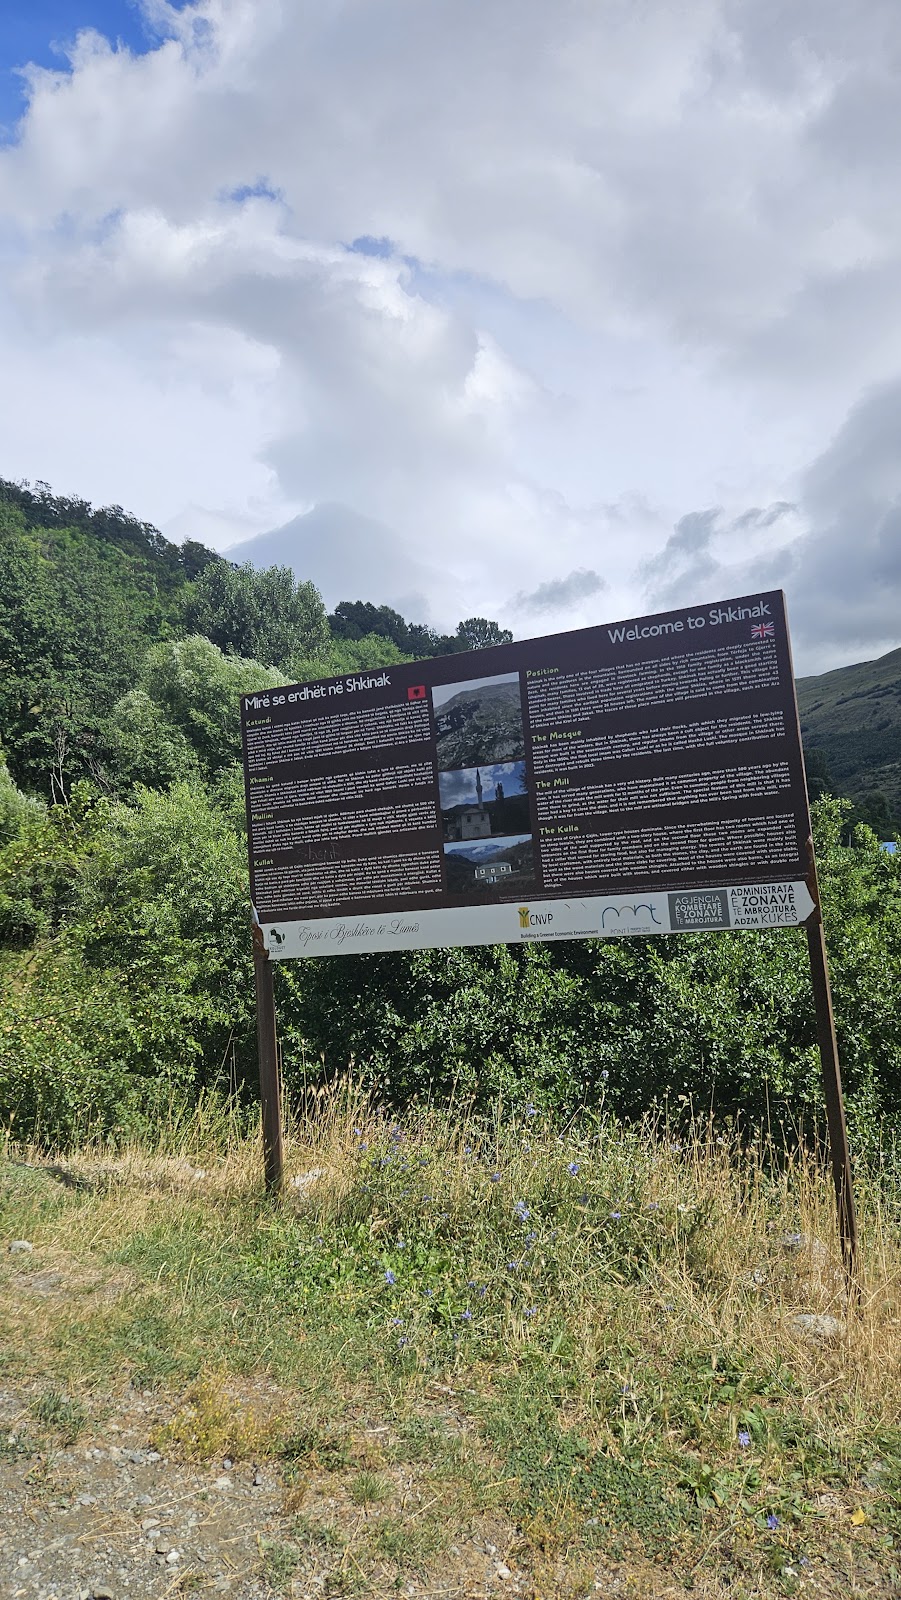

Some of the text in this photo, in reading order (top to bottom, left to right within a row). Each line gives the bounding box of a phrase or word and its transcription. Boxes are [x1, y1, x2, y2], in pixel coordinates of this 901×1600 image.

[607, 600, 771, 644] Welcome to Shkinak
[526, 667, 559, 678] Position
[244, 672, 391, 711] Mirë se erdhët në Shkinak
[245, 716, 272, 727] Katundi
[531, 730, 582, 742] The Mosque
[249, 775, 273, 785] Xhamia
[535, 777, 569, 789] The Mill
[251, 812, 273, 821] Mullini
[539, 824, 579, 835] The Kulla
[253, 858, 273, 867] Kullat
[731, 884, 794, 896] ADMINISTRATA
[675, 896, 720, 904] AGJENCIA
[732, 893, 794, 907] E ZONAVE
[684, 908, 723, 918] ZONAVE
[744, 905, 797, 915] MBROJTURA
[530, 914, 554, 925] CNVP
[685, 916, 723, 924] MBROJTURA
[734, 917, 758, 925] ADZM
[298, 919, 420, 947] Eposi i Bjeshkëve të Lumës
